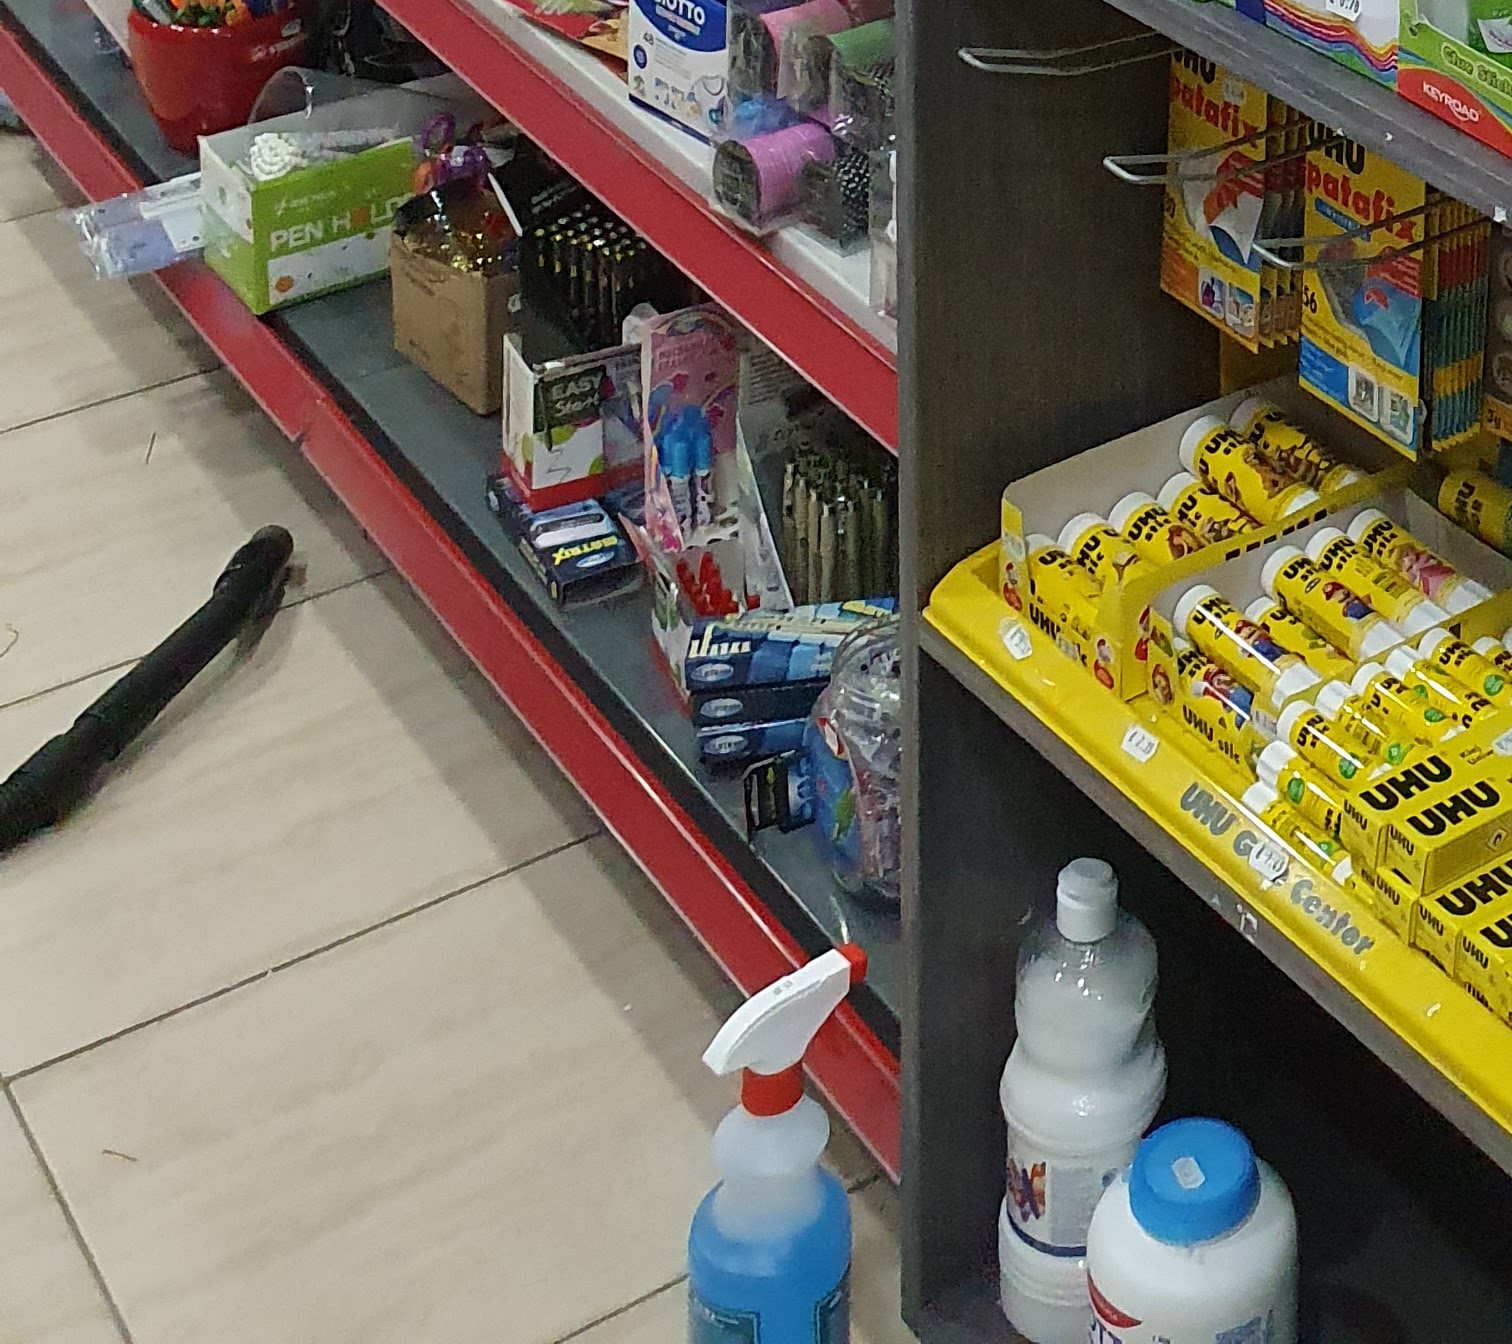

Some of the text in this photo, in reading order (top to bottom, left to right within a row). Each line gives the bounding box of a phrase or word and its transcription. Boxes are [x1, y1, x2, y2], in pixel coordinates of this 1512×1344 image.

[1443, 45, 1475, 78] Glue
[1422, 80, 1480, 124] KEYROAD
[270, 219, 324, 253] PEN
[1181, 704, 1214, 743] UHU
[1358, 754, 1455, 812] UHU
[1181, 781, 1236, 836] UHU
[1405, 780, 1502, 837] UHU
